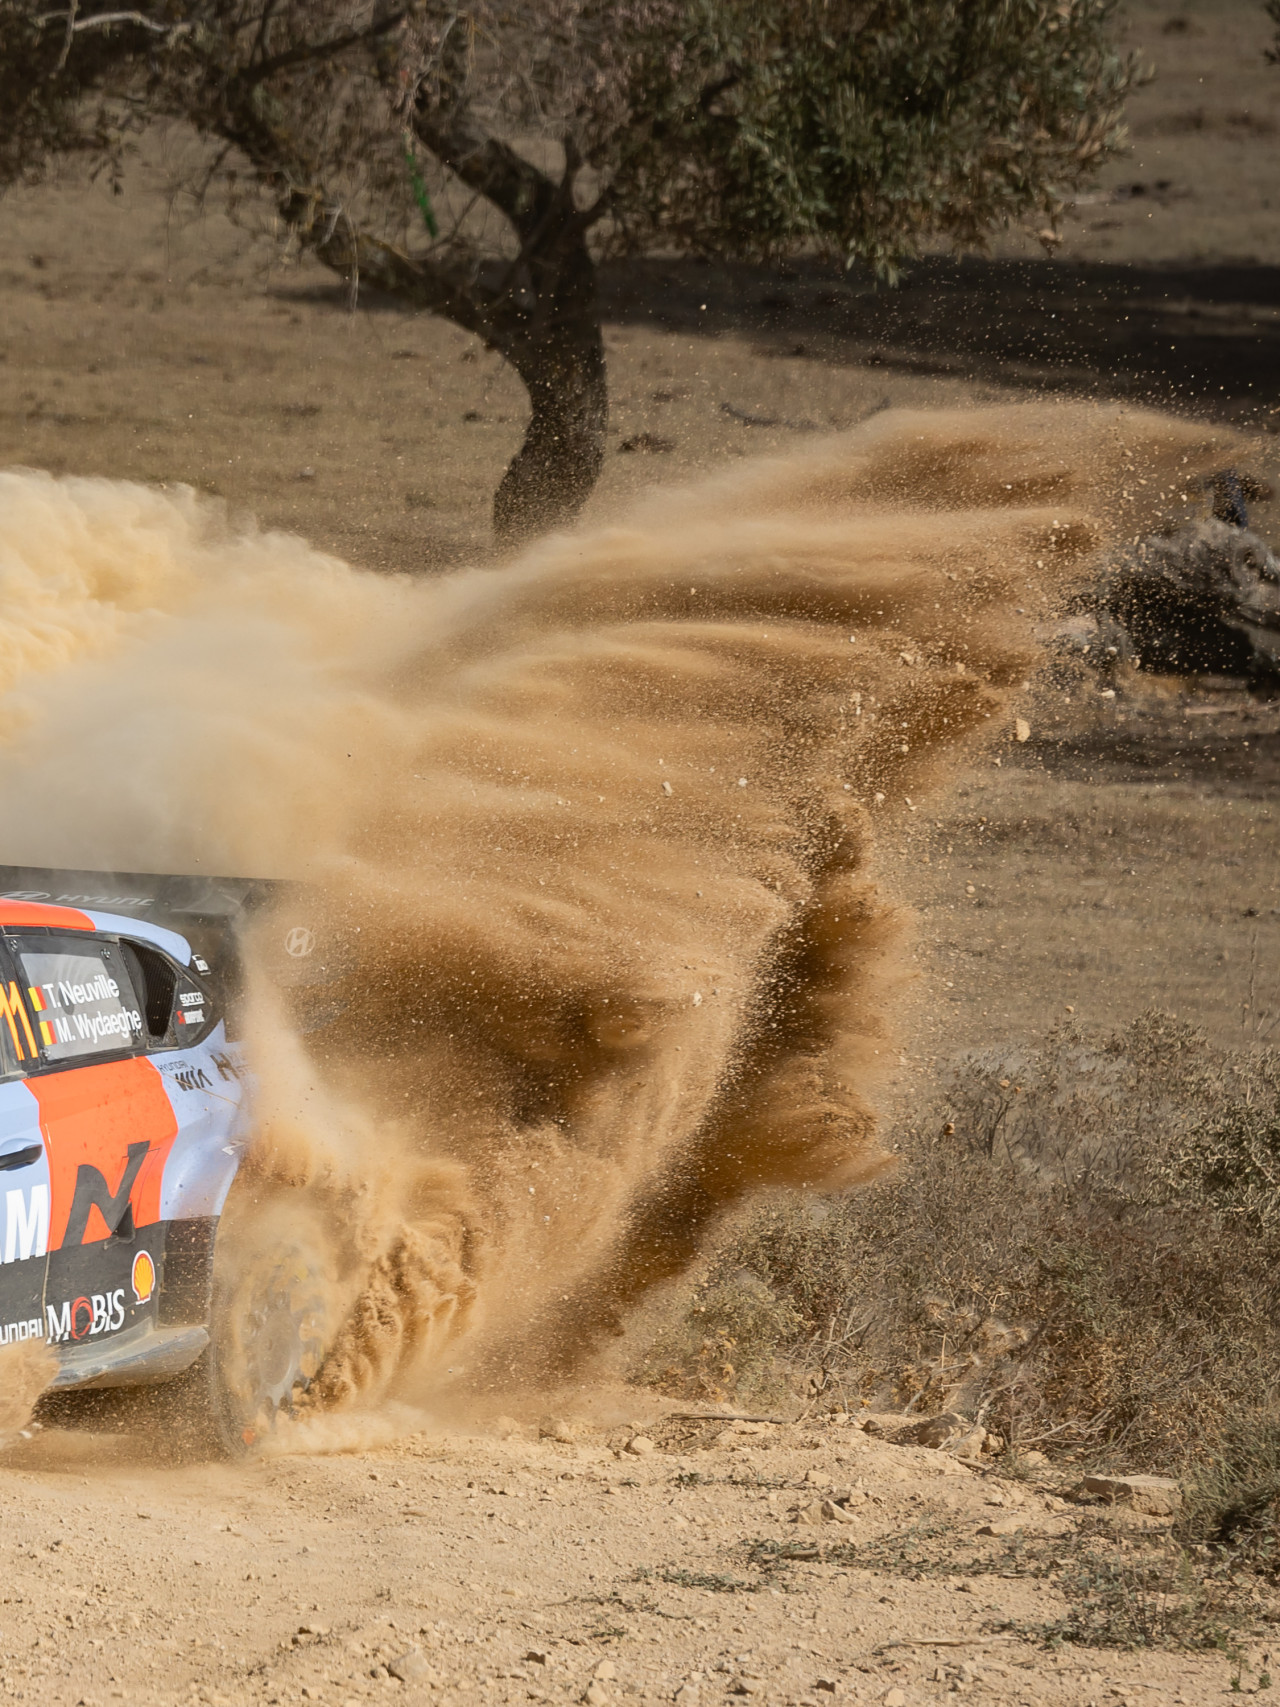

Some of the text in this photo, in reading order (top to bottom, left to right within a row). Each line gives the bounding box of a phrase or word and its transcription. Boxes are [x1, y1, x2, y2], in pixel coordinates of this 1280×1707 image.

[42, 974, 120, 1009] T. Neuville
[55, 1018, 76, 1044] M.
[73, 1006, 143, 1044] Wydaeghe
[45, 1288, 126, 1345] MOBIS
